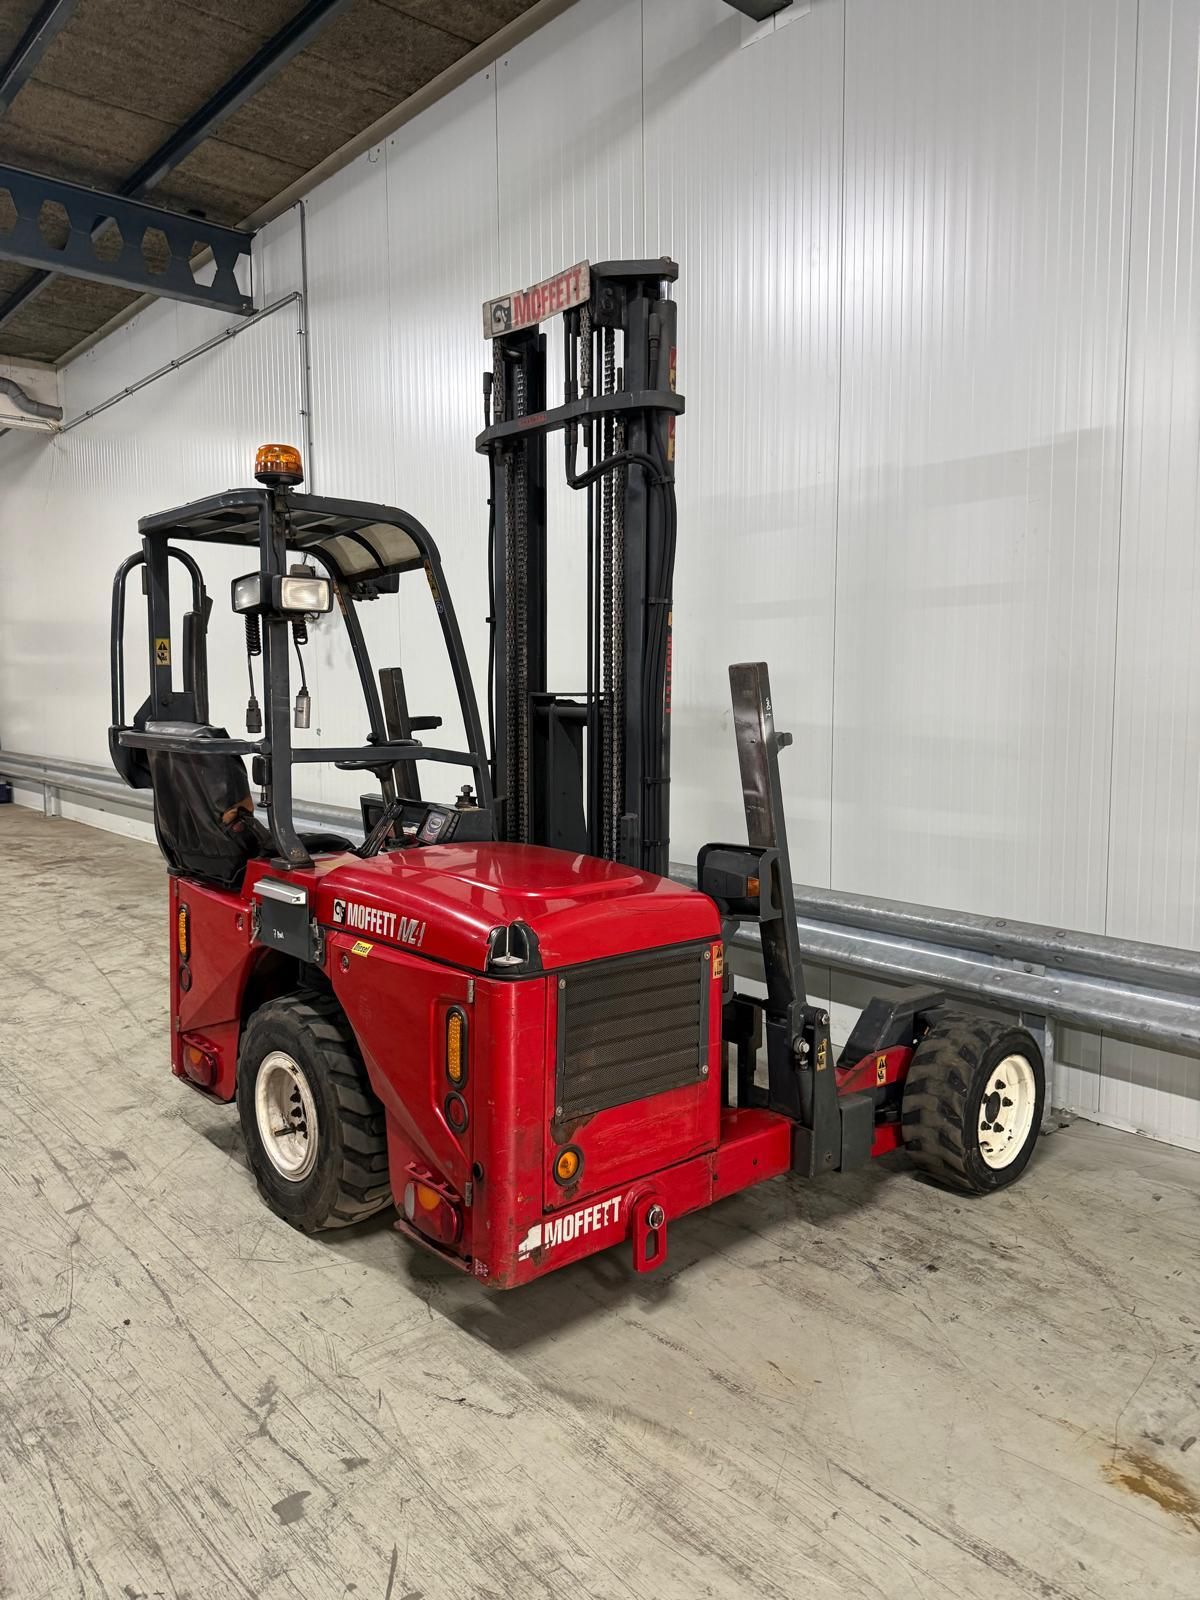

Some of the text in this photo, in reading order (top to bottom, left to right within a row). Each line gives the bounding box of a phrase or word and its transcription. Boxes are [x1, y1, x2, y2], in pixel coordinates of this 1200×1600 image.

[512, 266, 581, 326] MOFFETT
[347, 902, 396, 938] MOFFETT
[544, 1195, 622, 1250] MOFFETT
